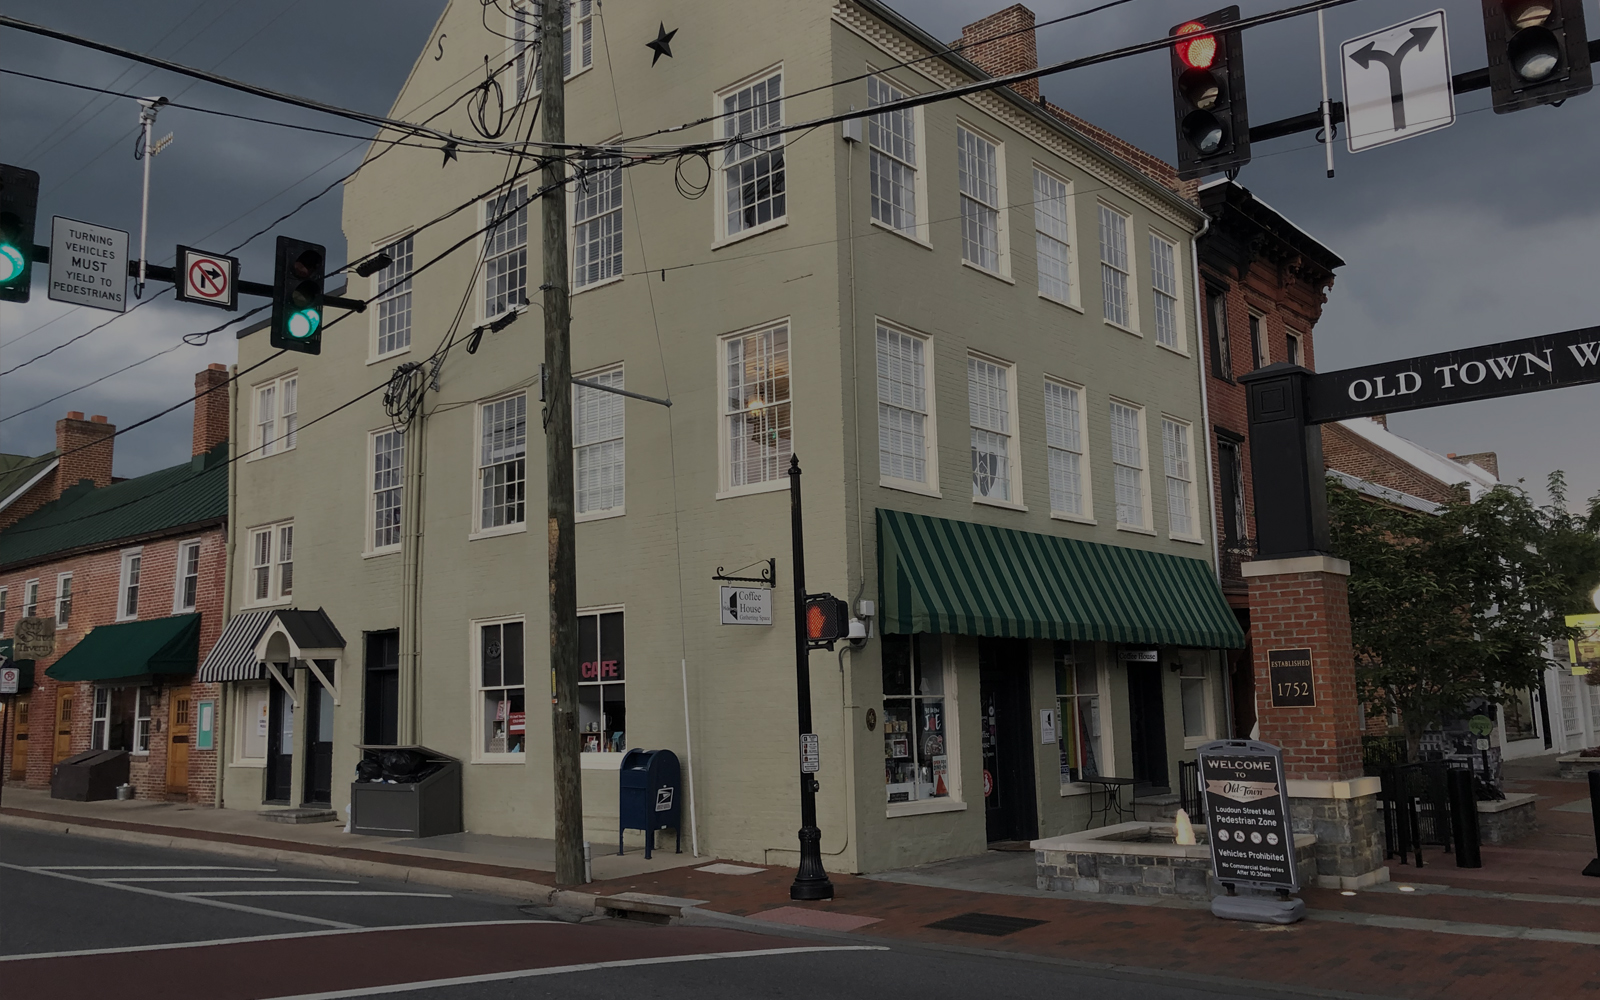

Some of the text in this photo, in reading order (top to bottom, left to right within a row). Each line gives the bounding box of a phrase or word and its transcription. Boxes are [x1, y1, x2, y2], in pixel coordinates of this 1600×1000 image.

[69, 229, 113, 247] TURNING
[65, 242, 115, 260] VEHICLES
[72, 256, 107, 273] MUST
[66, 271, 112, 287] YIELD TO
[53, 281, 122, 302] PEDESTRIANS
[1348, 371, 1423, 402] OLD
[1433, 348, 1553, 389] TOWN
[738, 591, 762, 601] Coffee
[740, 603, 762, 614] House
[1119, 652, 1156, 660] Coffee House
[581, 660, 618, 678] CAFE
[1271, 660, 1310, 668] ESTABLISHED
[1277, 682, 1309, 697] 1752
[1207, 760, 1272, 771] WELCOME
[1223, 782, 1240, 795] Old
[1240, 785, 1263, 796] Town
[1215, 805, 1275, 816] Loudoun Street Mall
[1216, 815, 1277, 827] Pedestrian Zone
[1218, 848, 1285, 861] Vehicles Prohibited
[1229, 862, 1259, 870] Commercial
[1259, 865, 1284, 873] Deliveries
